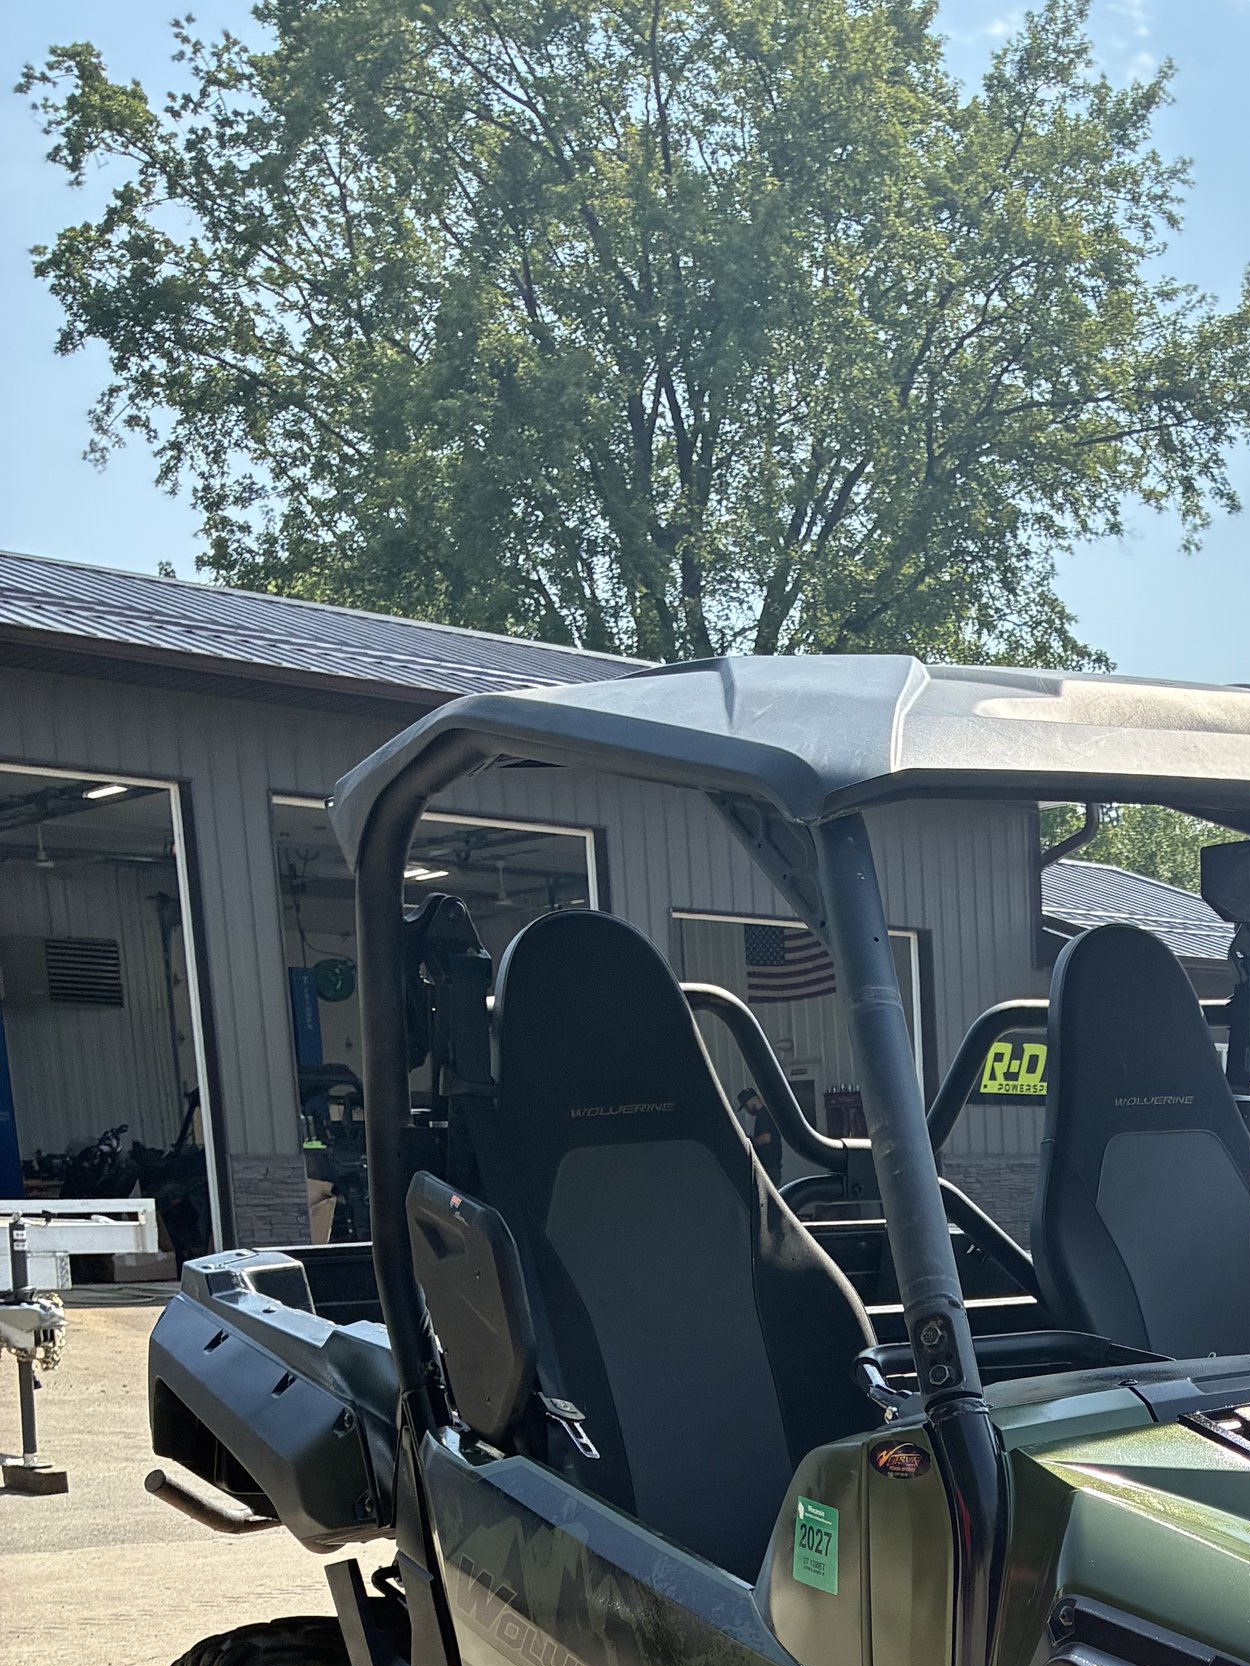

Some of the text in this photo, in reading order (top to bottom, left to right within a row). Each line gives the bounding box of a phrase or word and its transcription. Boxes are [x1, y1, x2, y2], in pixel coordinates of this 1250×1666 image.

[997, 1083, 1047, 1093] POWERSP
[1114, 1095, 1194, 1106] WOLVERINE
[569, 1102, 676, 1118] WOLVERINE
[799, 1522, 832, 1557] 2027
